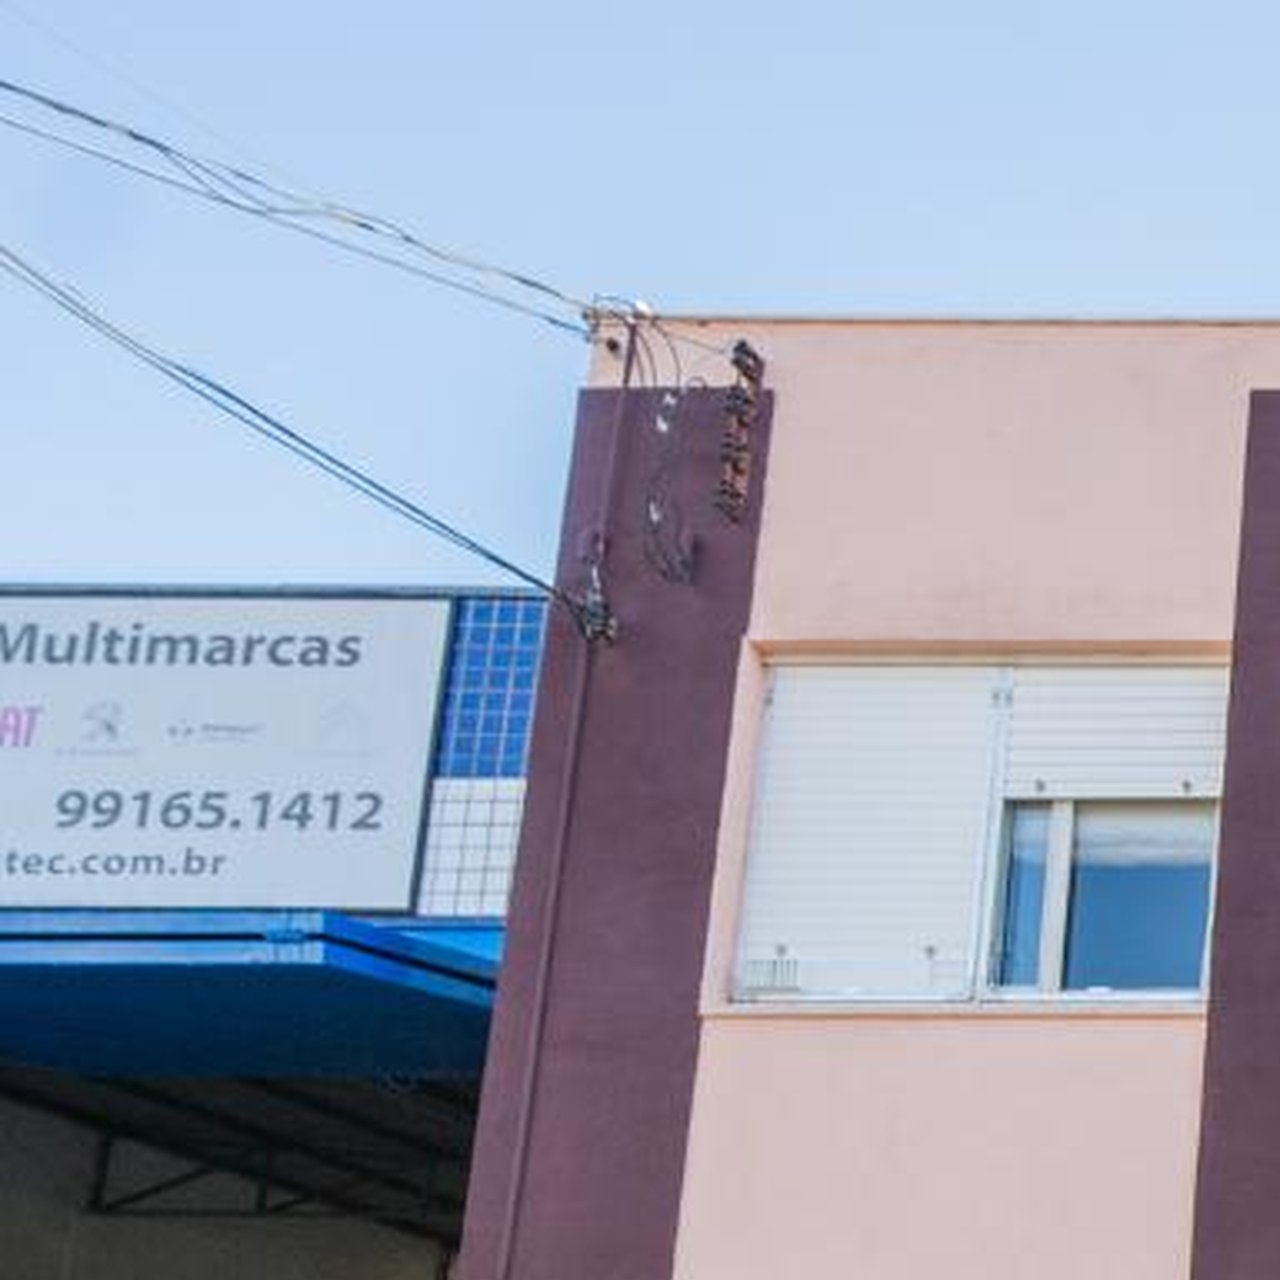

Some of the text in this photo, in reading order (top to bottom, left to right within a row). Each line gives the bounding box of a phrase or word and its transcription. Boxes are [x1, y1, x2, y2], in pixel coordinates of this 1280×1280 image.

[0, 622, 361, 668] Multimarcas
[55, 789, 383, 830] 99165.1412
[5, 847, 226, 876] tec.com.br
